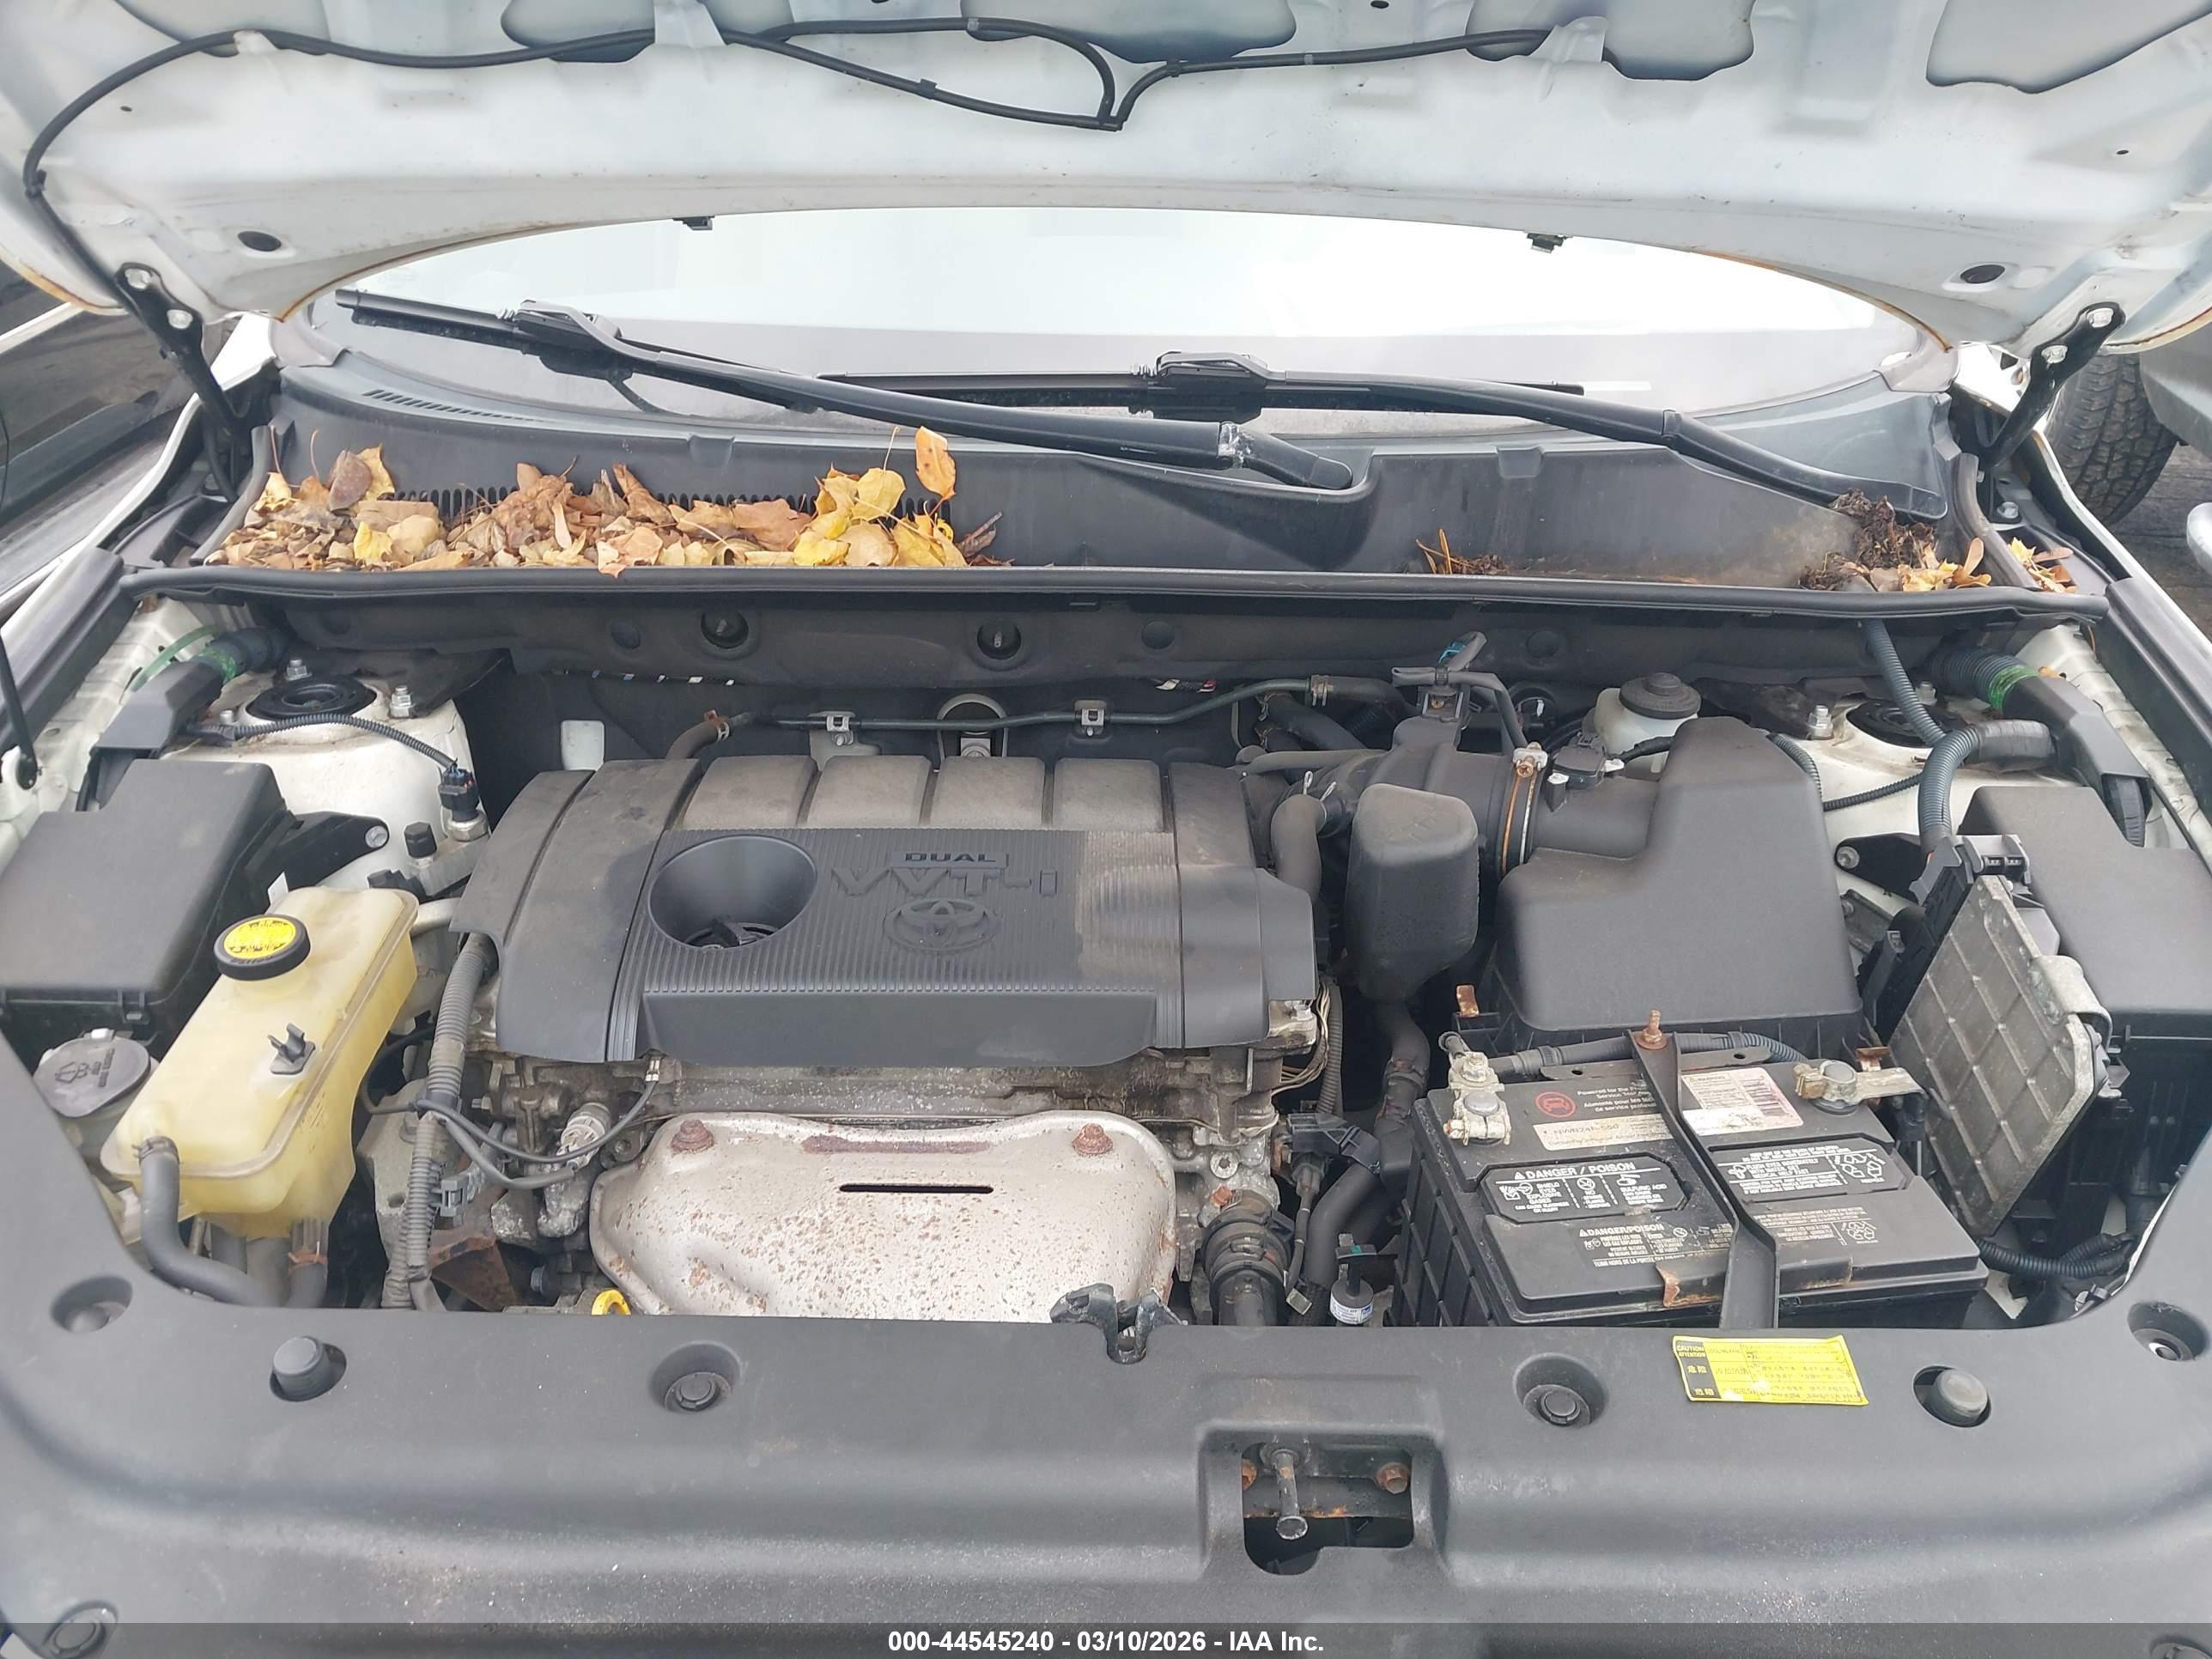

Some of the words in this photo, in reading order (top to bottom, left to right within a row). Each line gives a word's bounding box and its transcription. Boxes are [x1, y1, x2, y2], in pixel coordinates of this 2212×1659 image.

[905, 853, 996, 862] DUAL
[1525, 1167, 1577, 1179] DANGER
[1580, 1166, 1585, 1175] /
[1588, 1162, 1636, 1174] POISON
